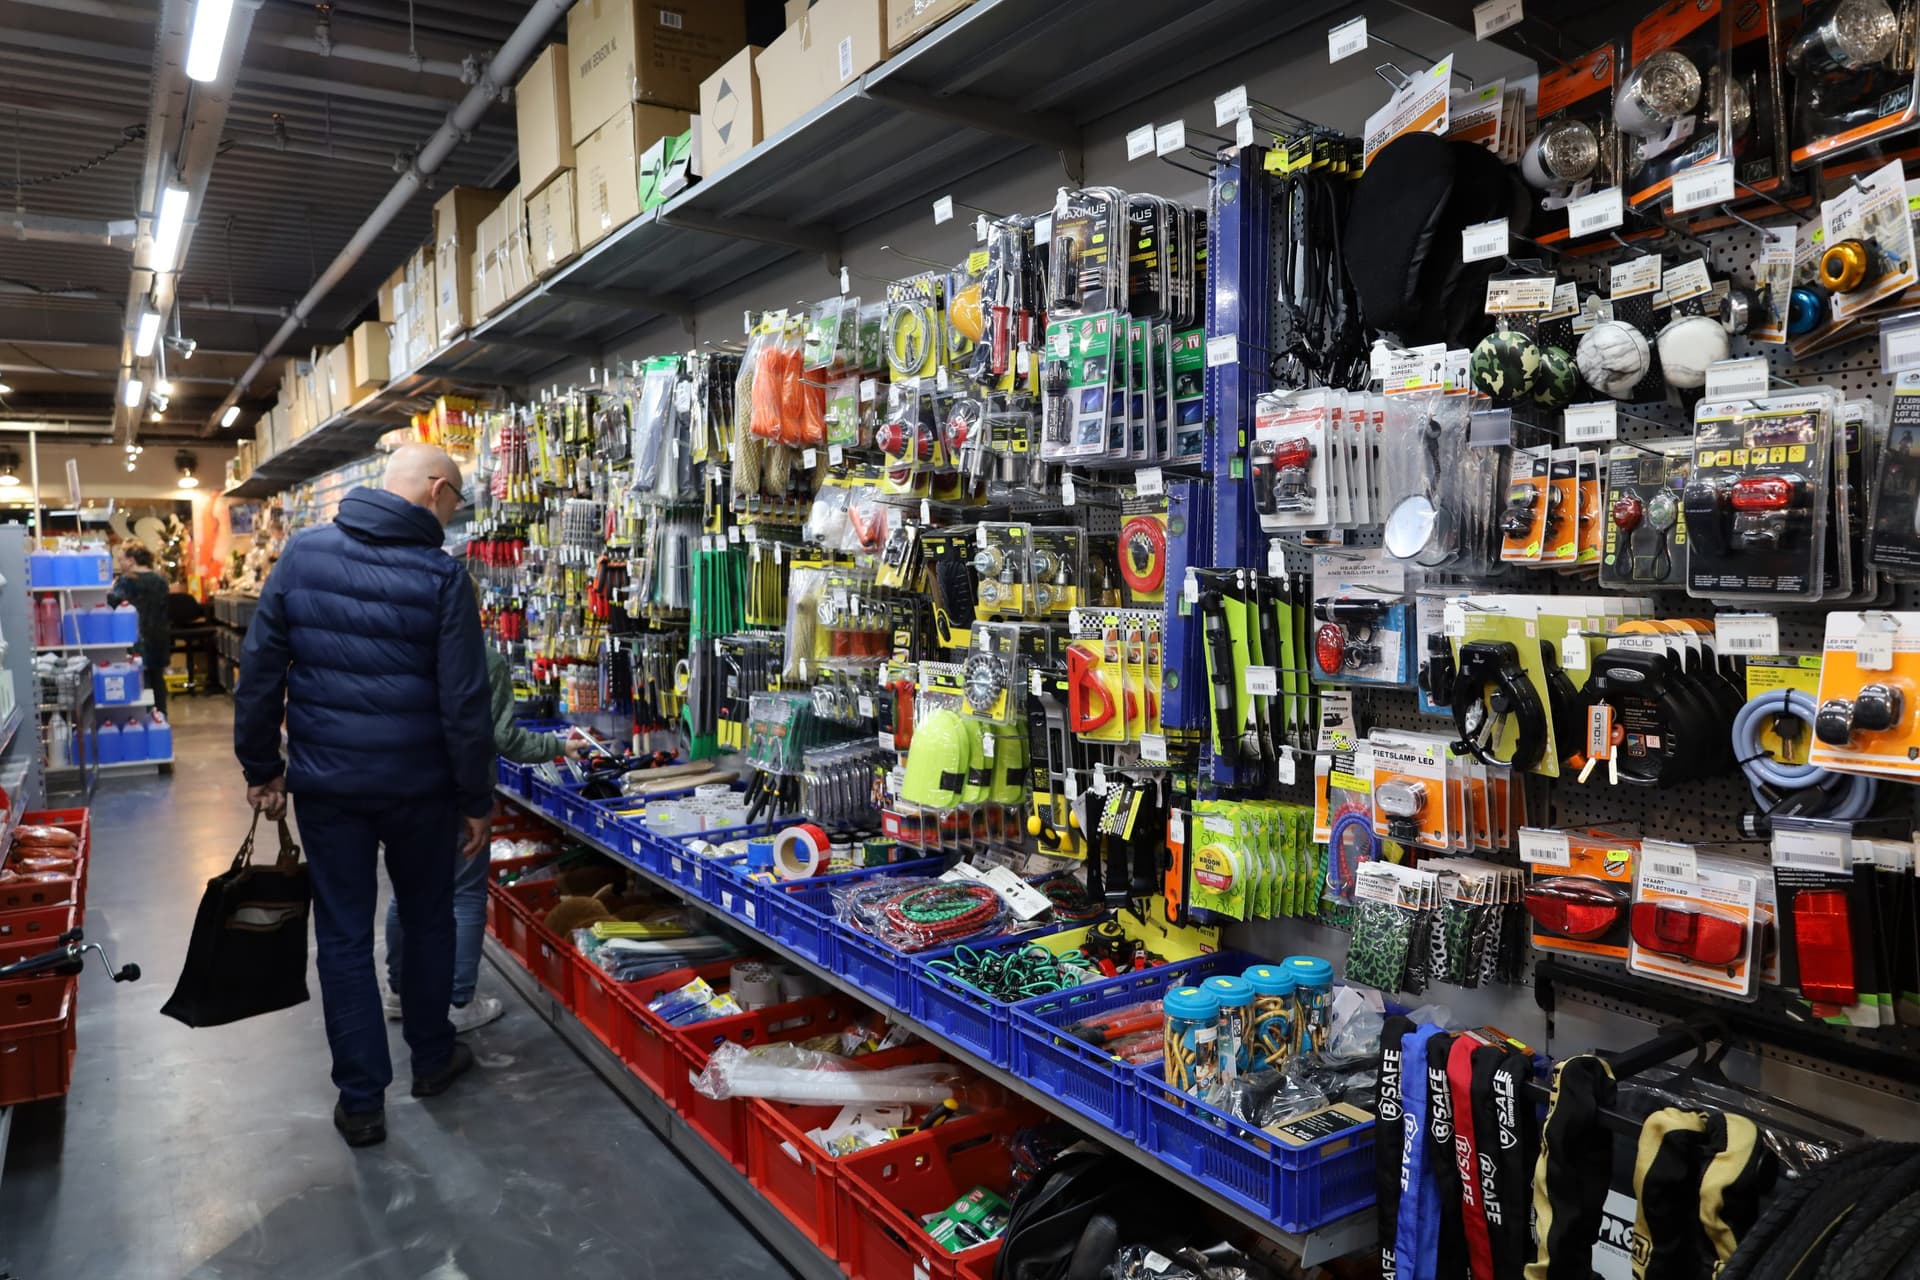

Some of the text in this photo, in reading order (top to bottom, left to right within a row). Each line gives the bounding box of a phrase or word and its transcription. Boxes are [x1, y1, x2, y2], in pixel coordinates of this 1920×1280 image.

[1057, 203, 1106, 221] MAXIMUS
[1832, 208, 1853, 226] FIETS
[1618, 639, 1654, 647] XOLID
[1594, 712, 1602, 745] XOLID
[1373, 750, 1434, 766] FIETSLAMP LED
[1200, 857, 1220, 866] KROON
[1642, 883, 1676, 893] REFLECTOR
[1507, 1096, 1516, 1128] Germany
